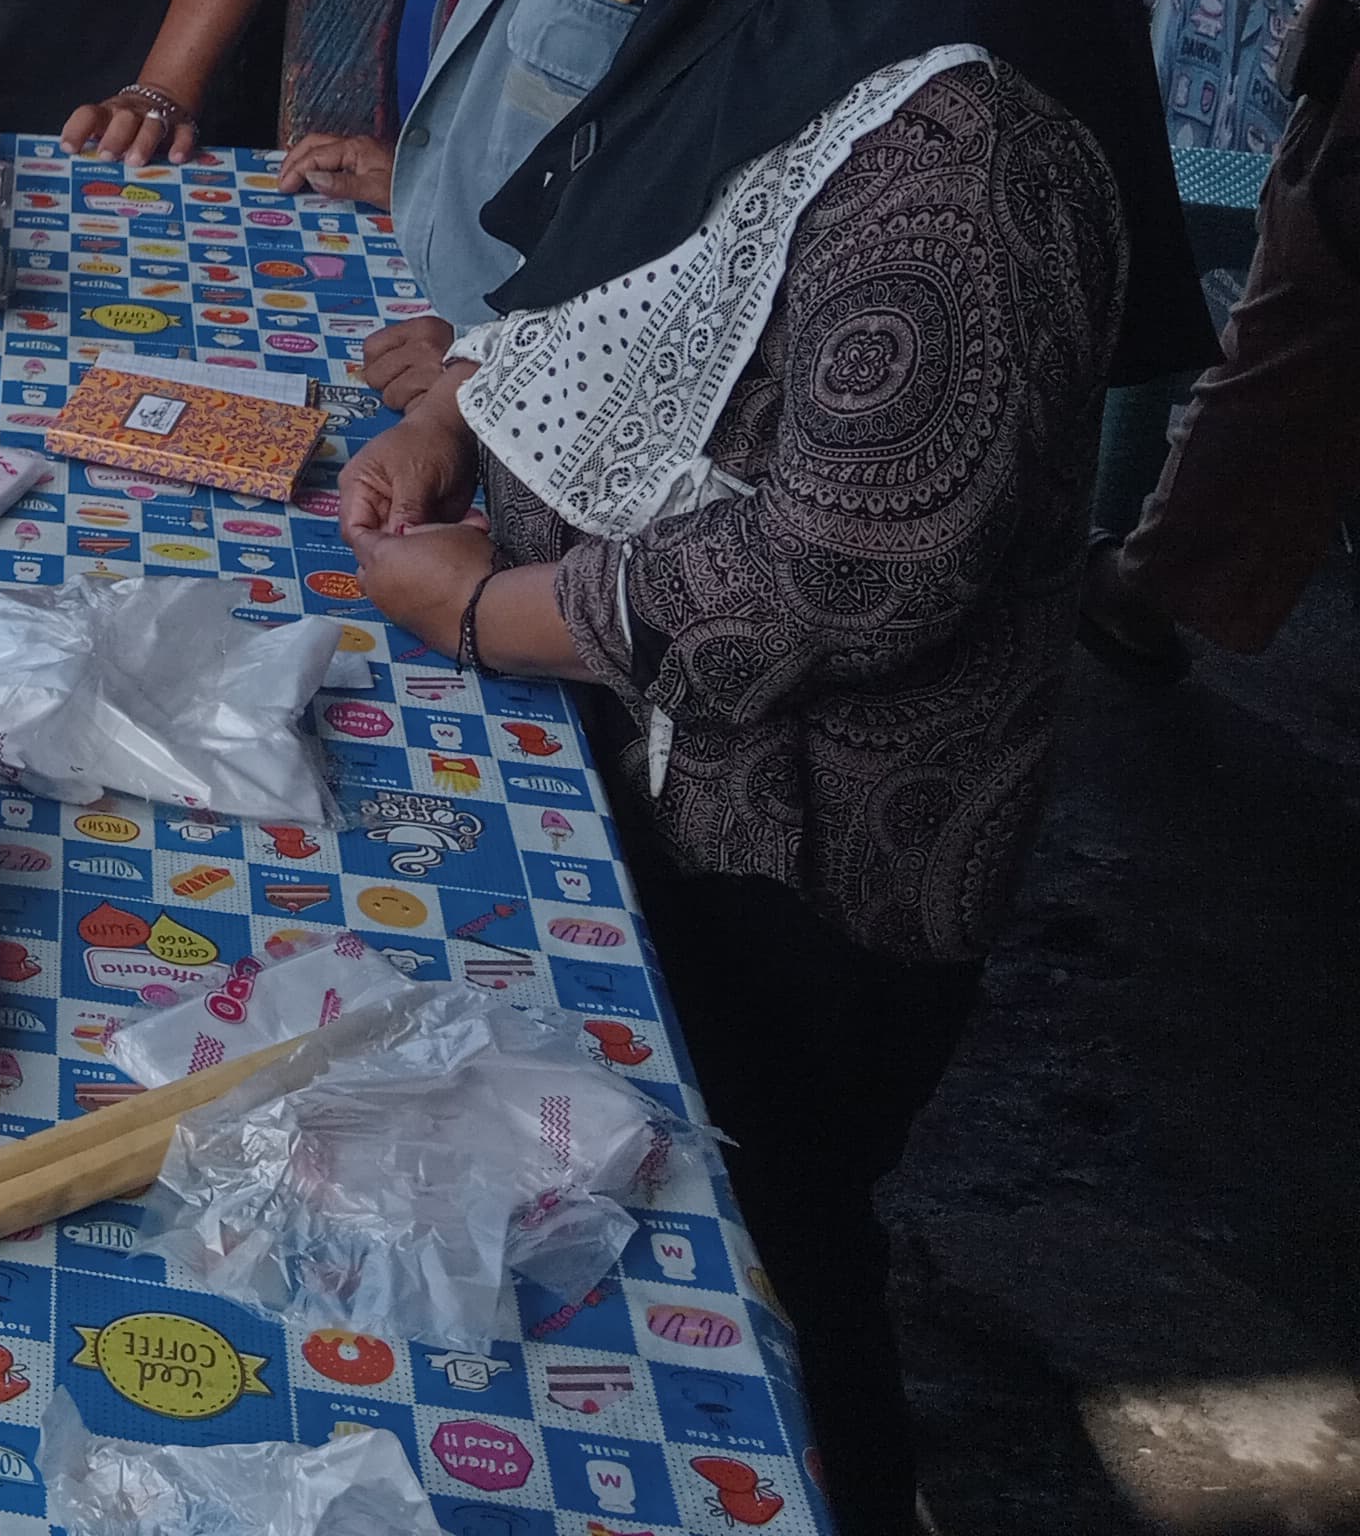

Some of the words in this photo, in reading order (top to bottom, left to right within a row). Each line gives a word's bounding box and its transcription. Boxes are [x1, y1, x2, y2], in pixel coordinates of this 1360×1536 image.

[377, 790, 452, 809] HOUSE
[361, 798, 484, 837] Coffee
[86, 923, 142, 940] yum
[99, 963, 205, 984] affetaria
[643, 1217, 691, 1231] milk
[122, 1330, 216, 1369] COFFEE
[137, 1359, 204, 1400] iced
[329, 1401, 380, 1418] cake
[685, 1429, 721, 1443] tea
[727, 1434, 766, 1450] hot
[579, 1443, 632, 1458] milk
[443, 1451, 519, 1476] d'fresh
